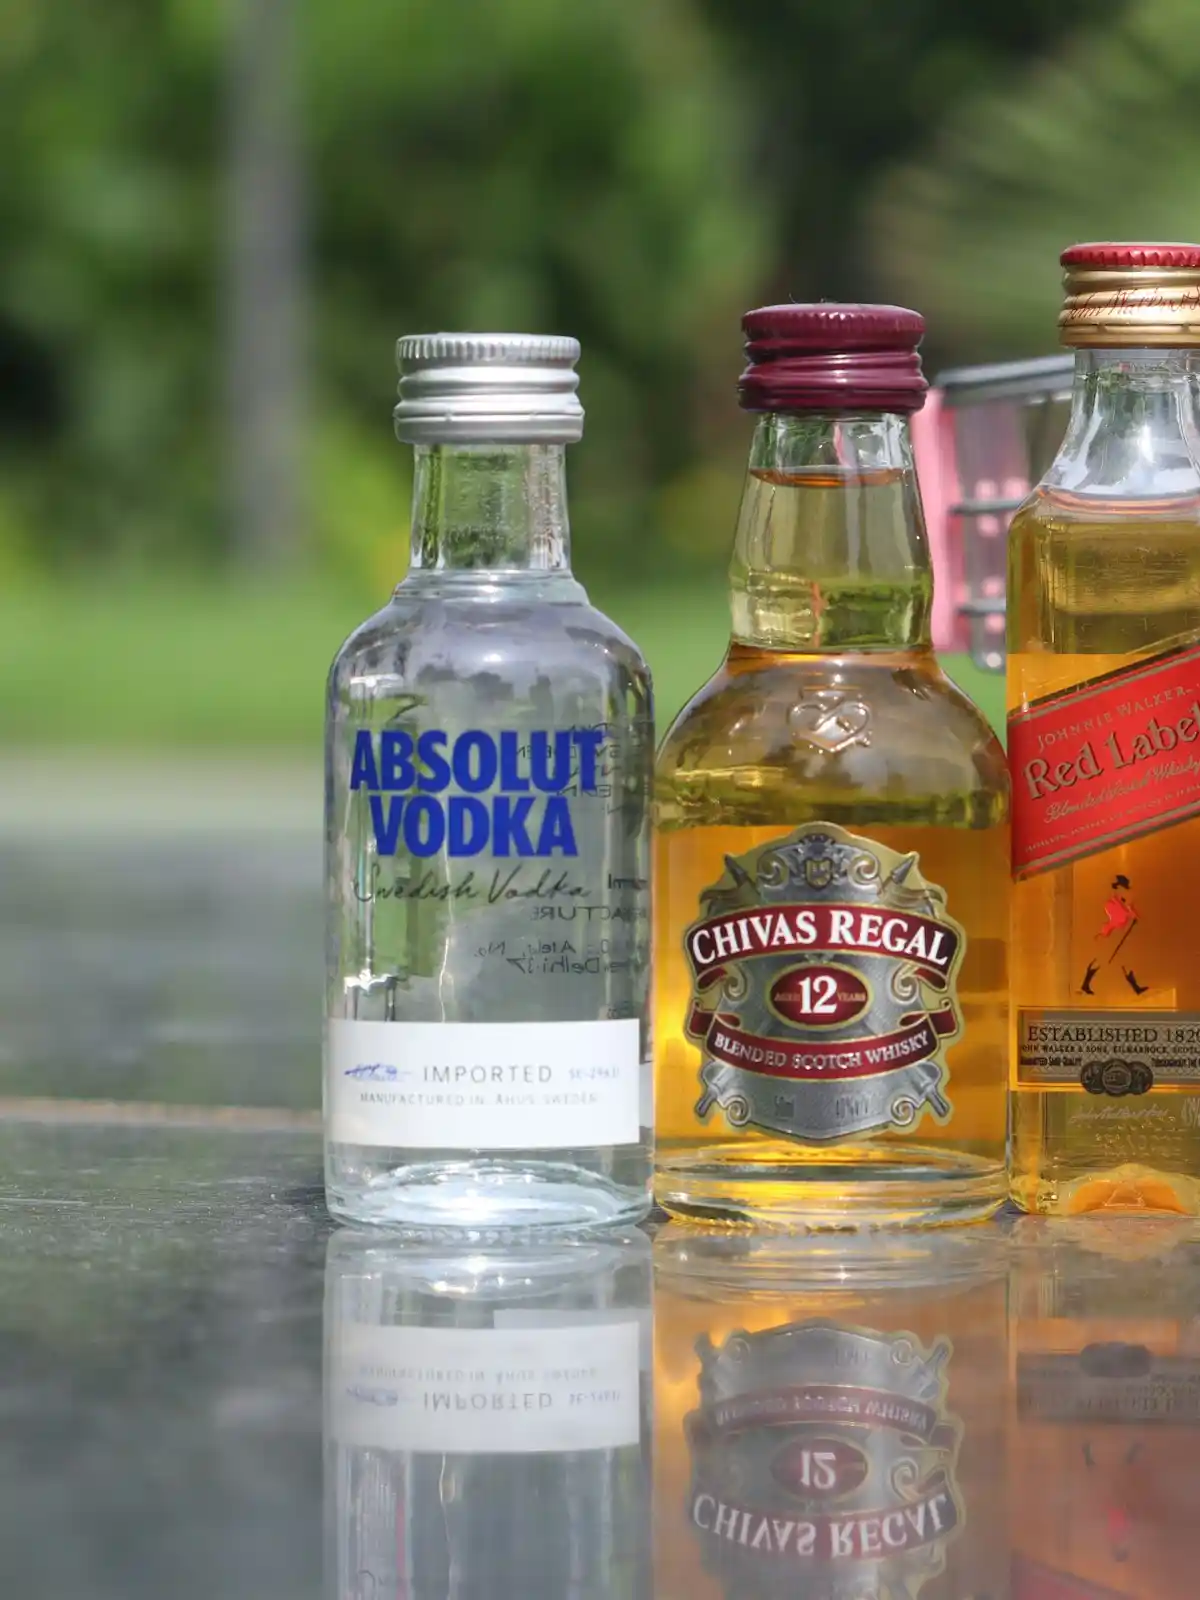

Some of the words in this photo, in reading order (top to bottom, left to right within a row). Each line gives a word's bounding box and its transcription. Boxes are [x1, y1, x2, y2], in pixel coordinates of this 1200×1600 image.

[1038, 712, 1112, 752] JOHNNIE
[1116, 686, 1187, 717] WALKER
[350, 729, 603, 793] ABSOLUT
[1023, 742, 1104, 801] Red
[370, 795, 579, 857] VODKA
[488, 864, 592, 903] Vodka
[692, 911, 817, 964] CHIVAS
[828, 909, 948, 965] REGAL
[798, 974, 837, 1014] 12
[714, 1032, 787, 1067] BLENDED
[792, 1051, 862, 1070] SCOTCH
[865, 1030, 929, 1064] WHISKY
[1027, 1025, 1158, 1043] ESTABLISHED
[423, 1065, 553, 1083] IMPORTED
[360, 1091, 465, 1106] MANUFACTURED
[469, 1094, 484, 1105] IN
